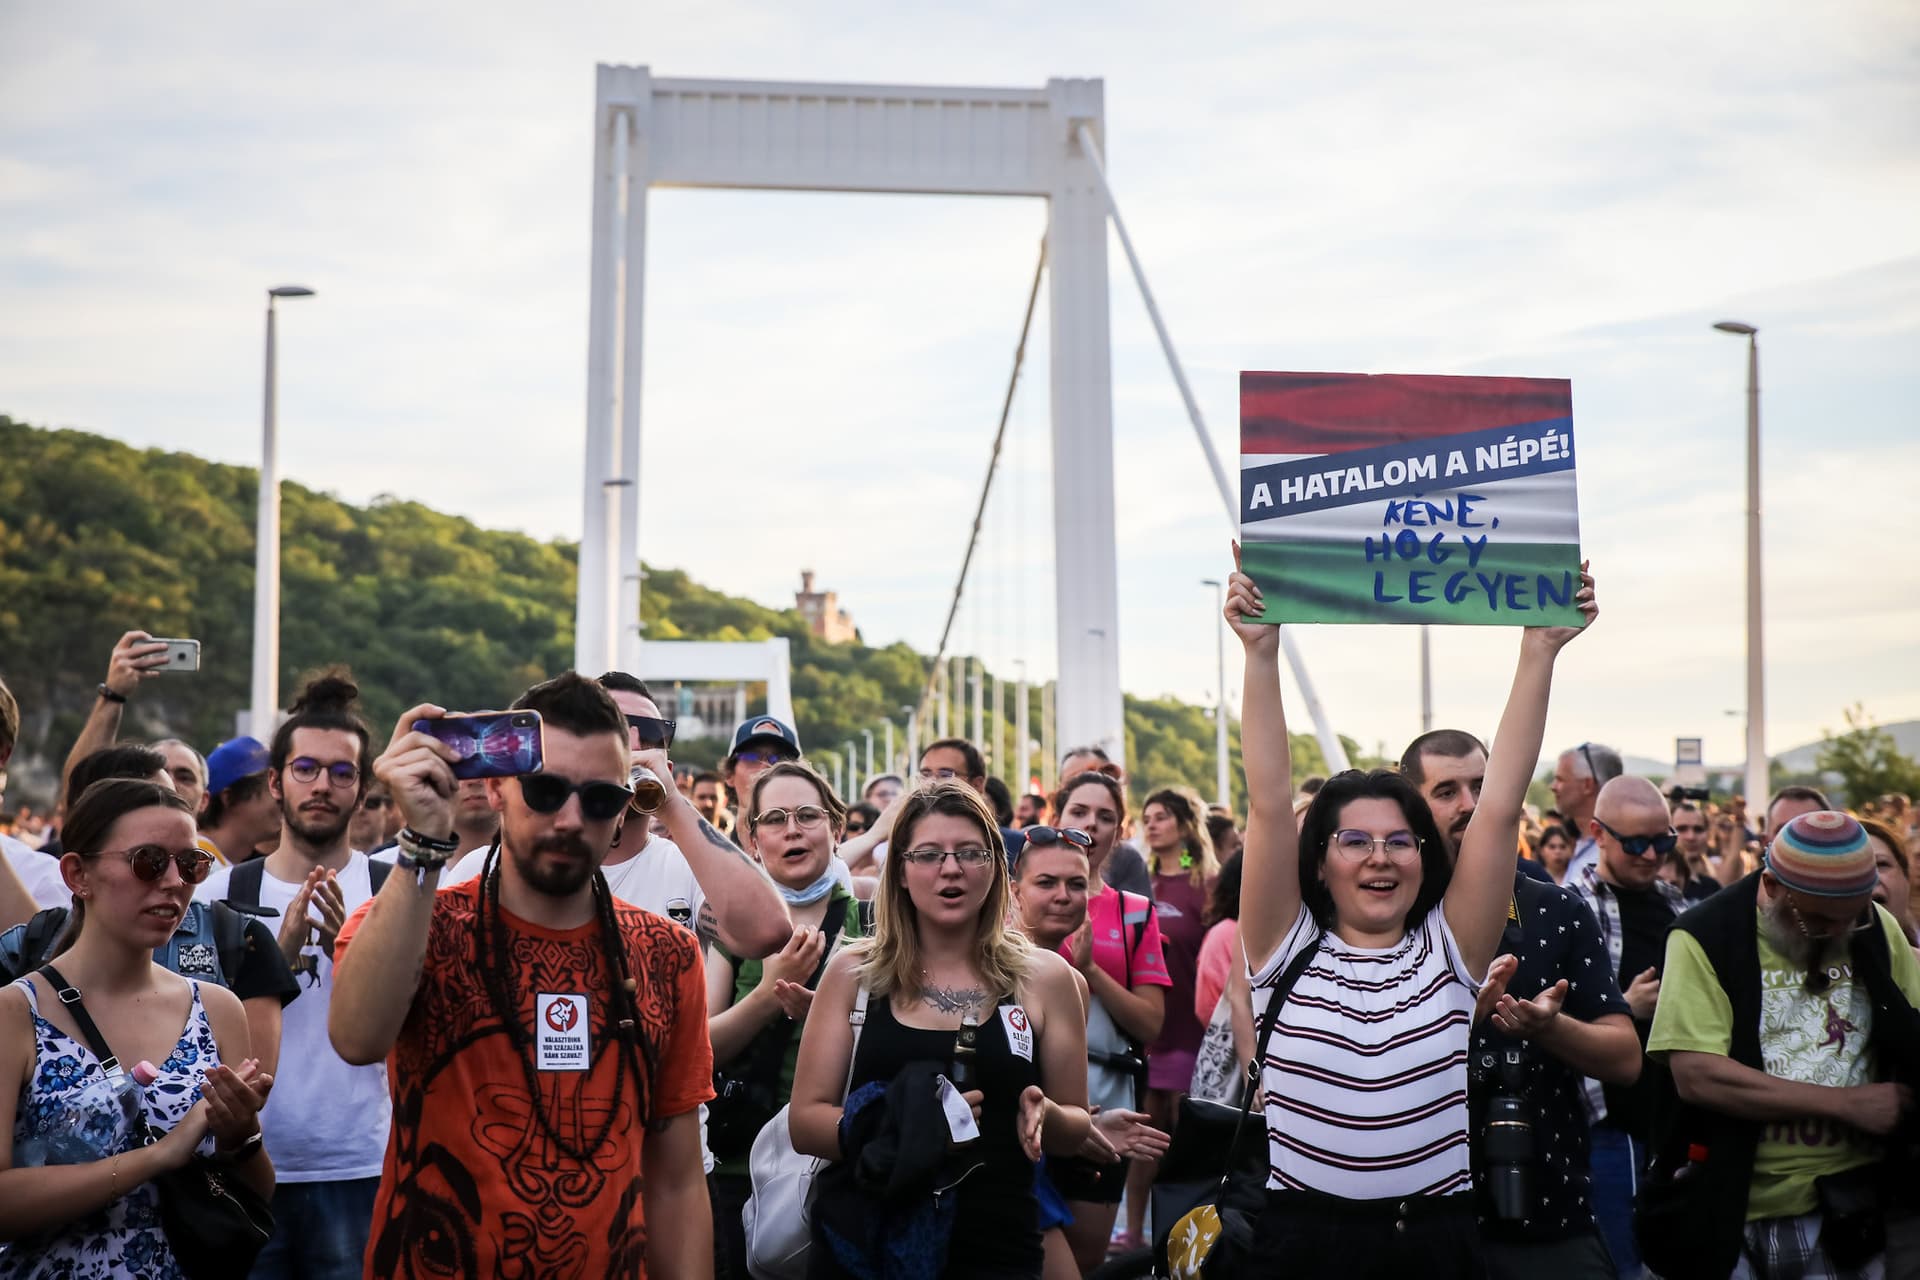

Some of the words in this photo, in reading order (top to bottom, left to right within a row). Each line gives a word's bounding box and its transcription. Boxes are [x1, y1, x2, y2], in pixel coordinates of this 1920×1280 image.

[1250, 482, 1274, 511] A
[1281, 454, 1436, 503] HATALOM
[1445, 450, 1468, 476] A
[1476, 429, 1570, 472] NÉPÉ!
[1365, 529, 1487, 569] HOGY
[1374, 570, 1572, 611] LEGYEN
